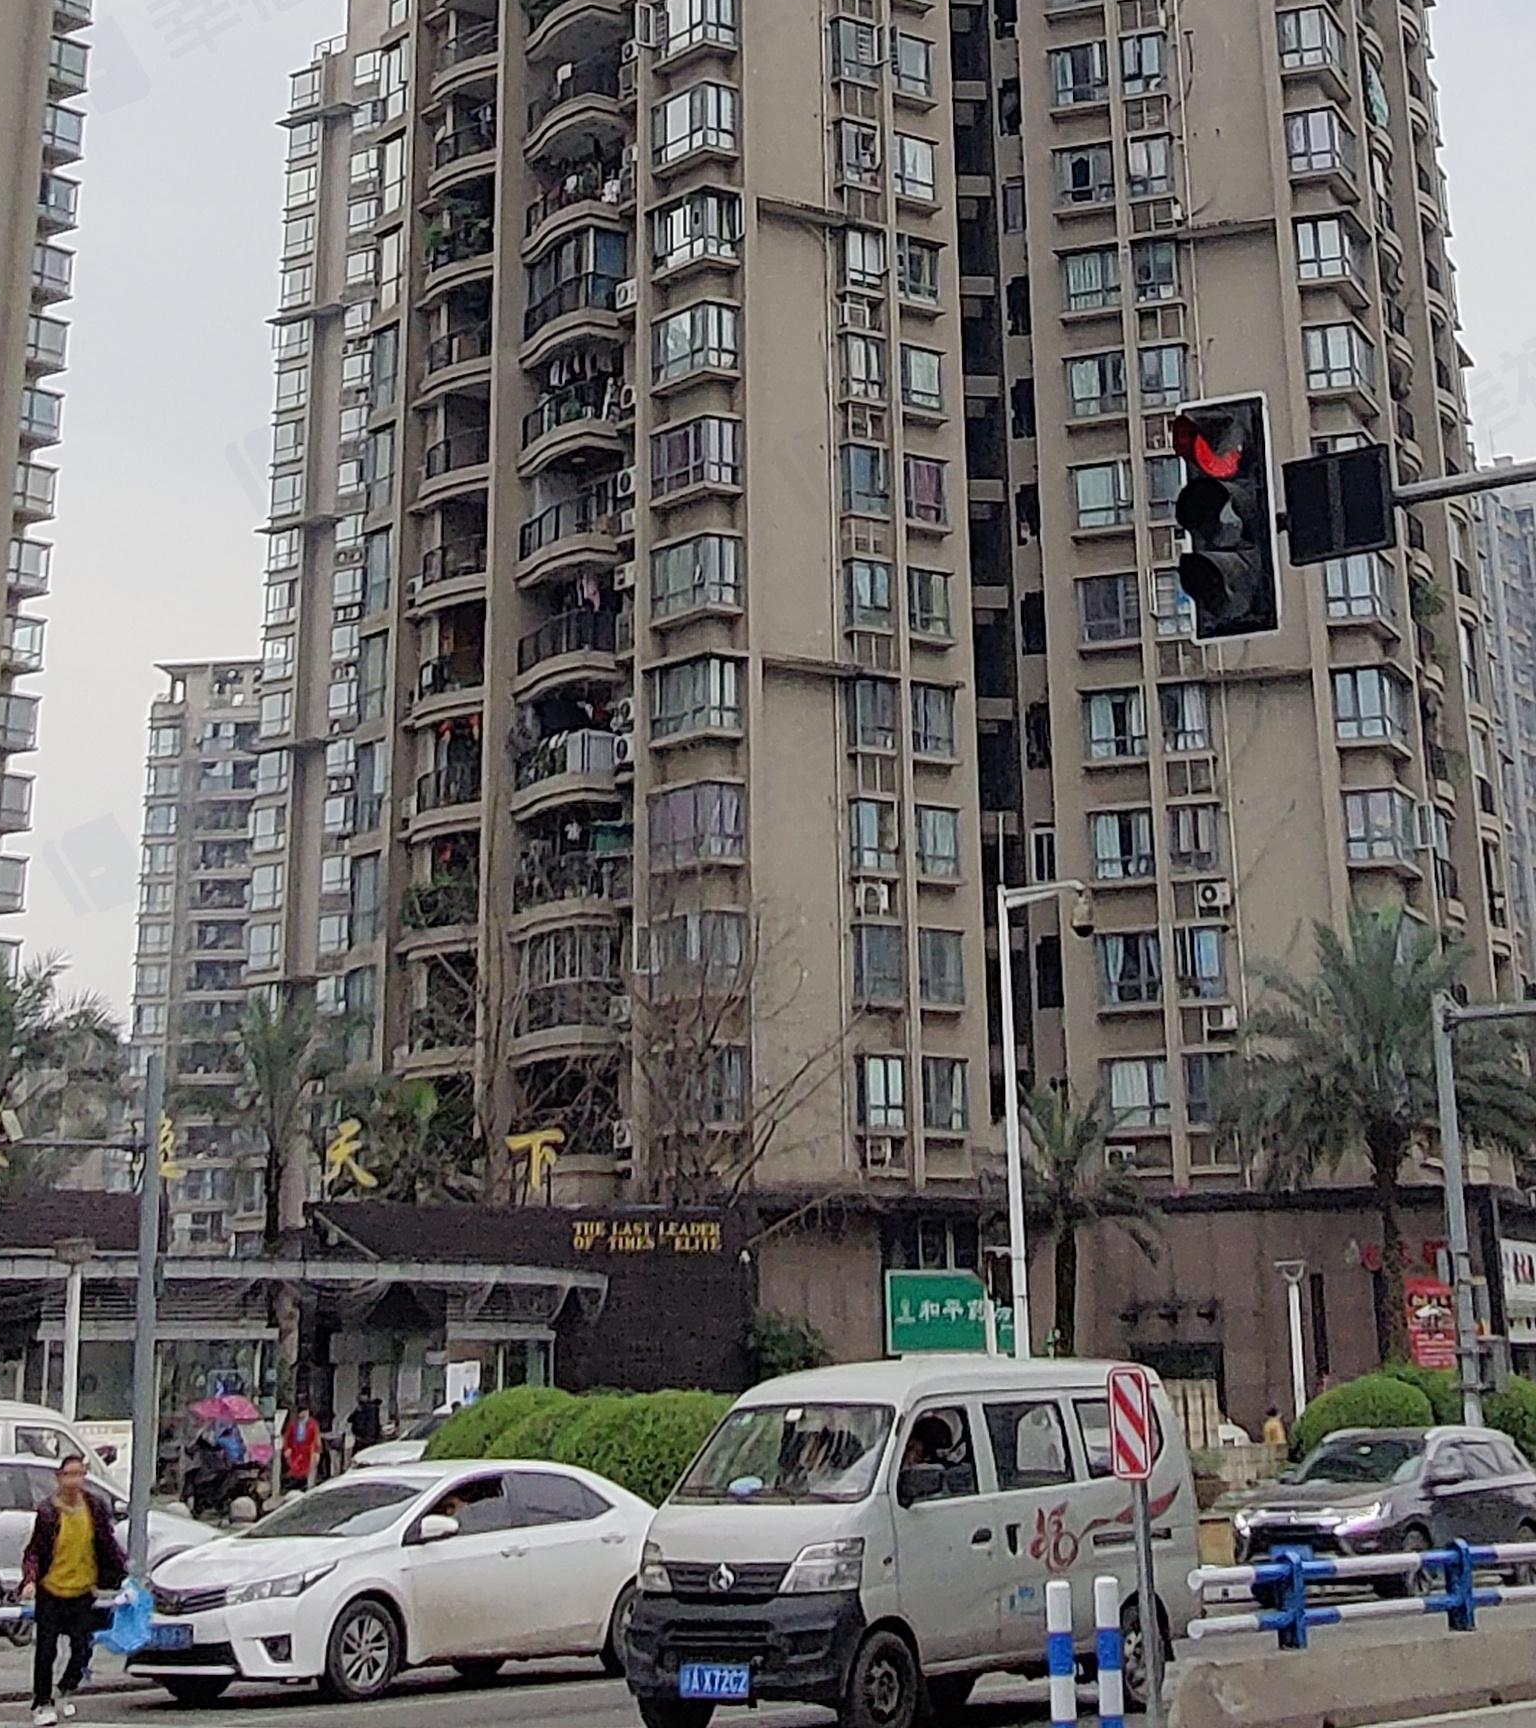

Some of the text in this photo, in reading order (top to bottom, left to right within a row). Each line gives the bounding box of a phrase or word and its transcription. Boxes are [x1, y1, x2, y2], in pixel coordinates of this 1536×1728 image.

[572, 1221, 722, 1238] THE LAST LEADER
[573, 1236, 722, 1251] OF TIMES ELITE
